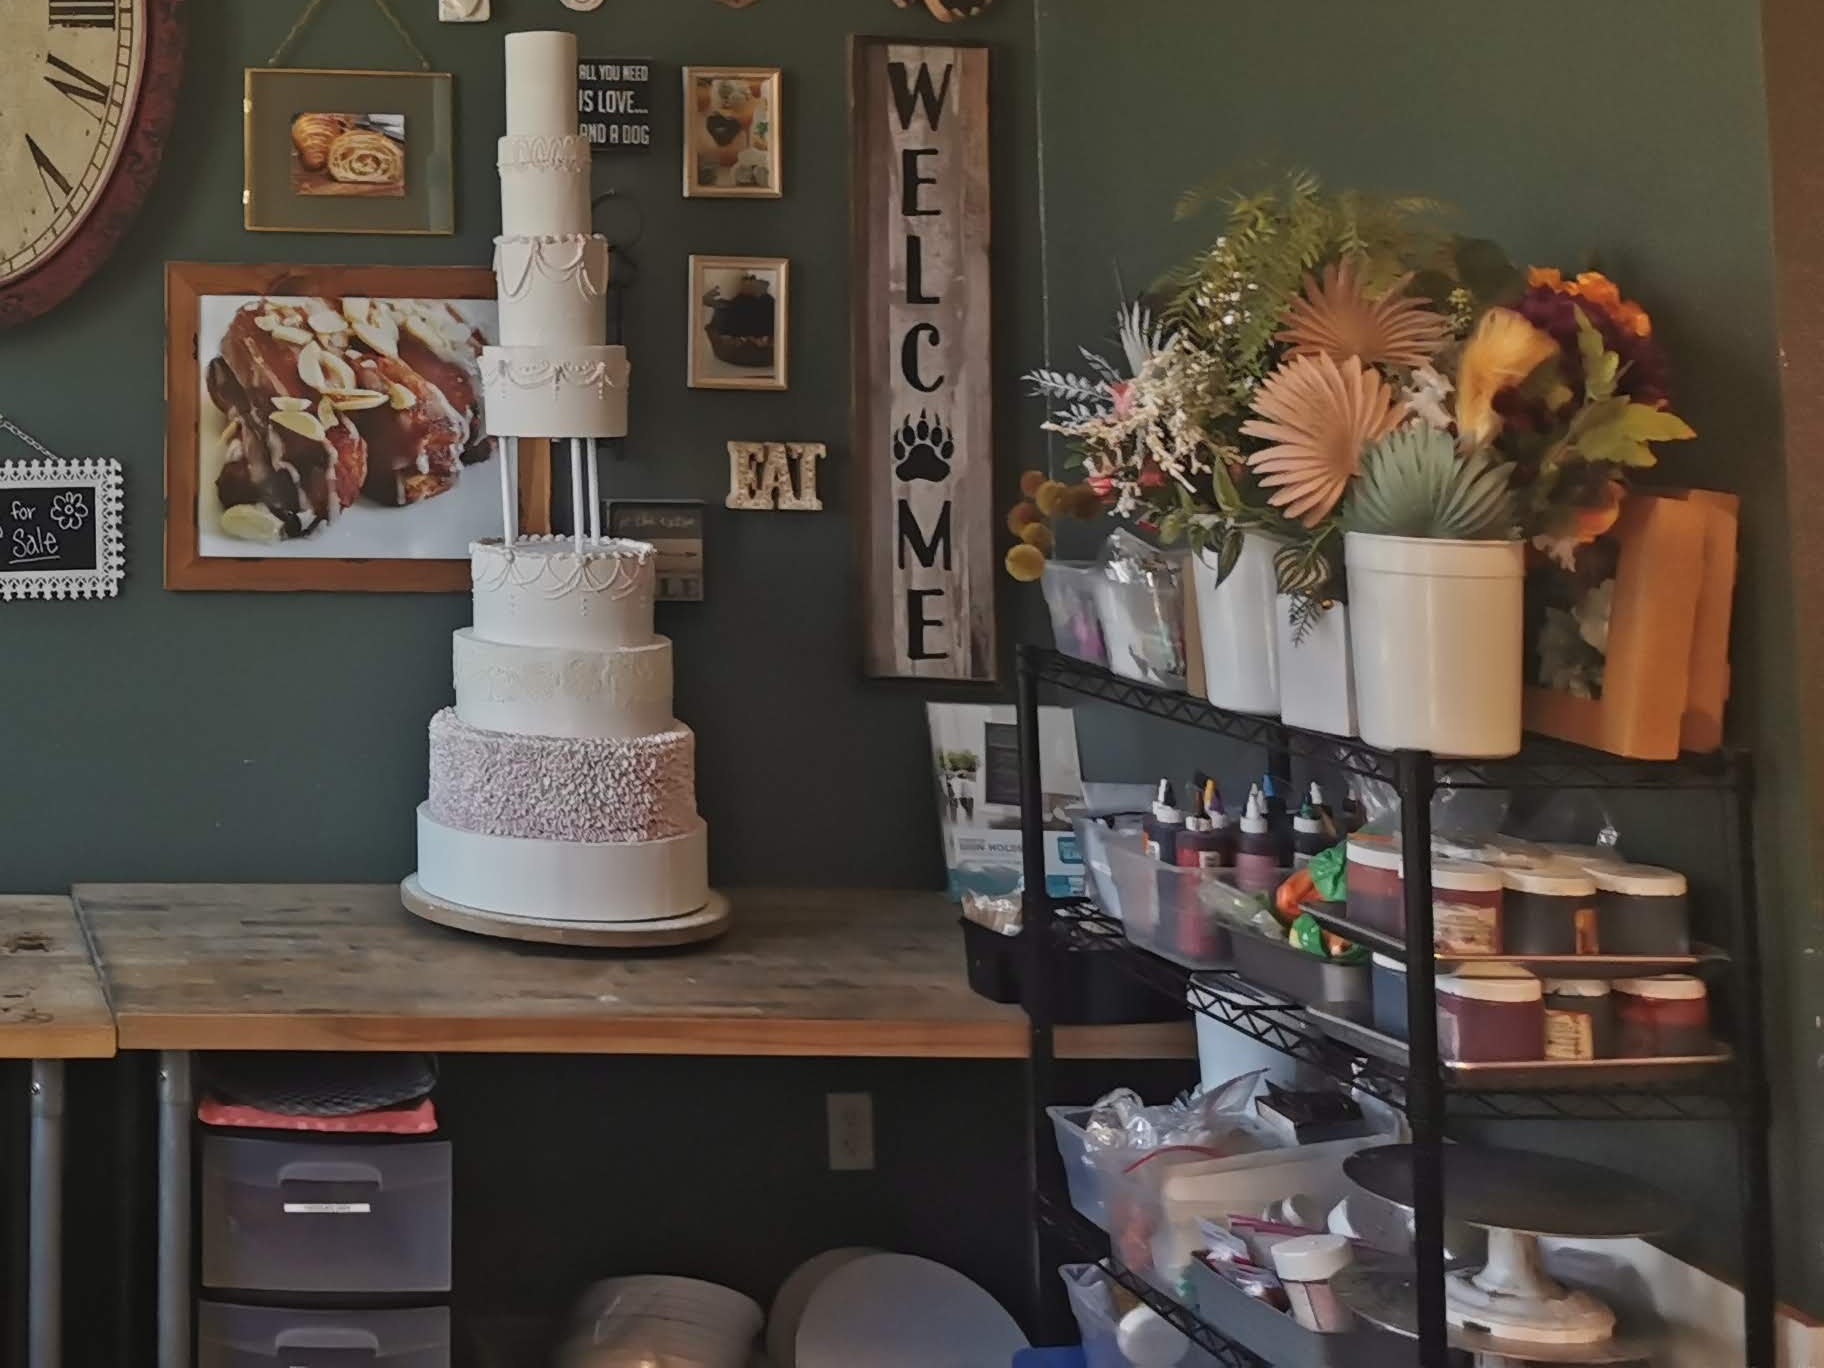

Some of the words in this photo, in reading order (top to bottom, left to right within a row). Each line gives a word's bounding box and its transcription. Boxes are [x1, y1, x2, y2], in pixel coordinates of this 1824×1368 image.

[578, 64, 596, 81] ALL
[598, 64, 621, 81] YOU
[622, 65, 649, 81] NEED
[578, 89, 594, 112] IS
[579, 123, 607, 144] AND
[609, 124, 619, 144] A
[622, 124, 650, 145] DOG
[725, 440, 827, 510] EAT
[10, 500, 37, 522] for
[12, 527, 59, 559] Sale
